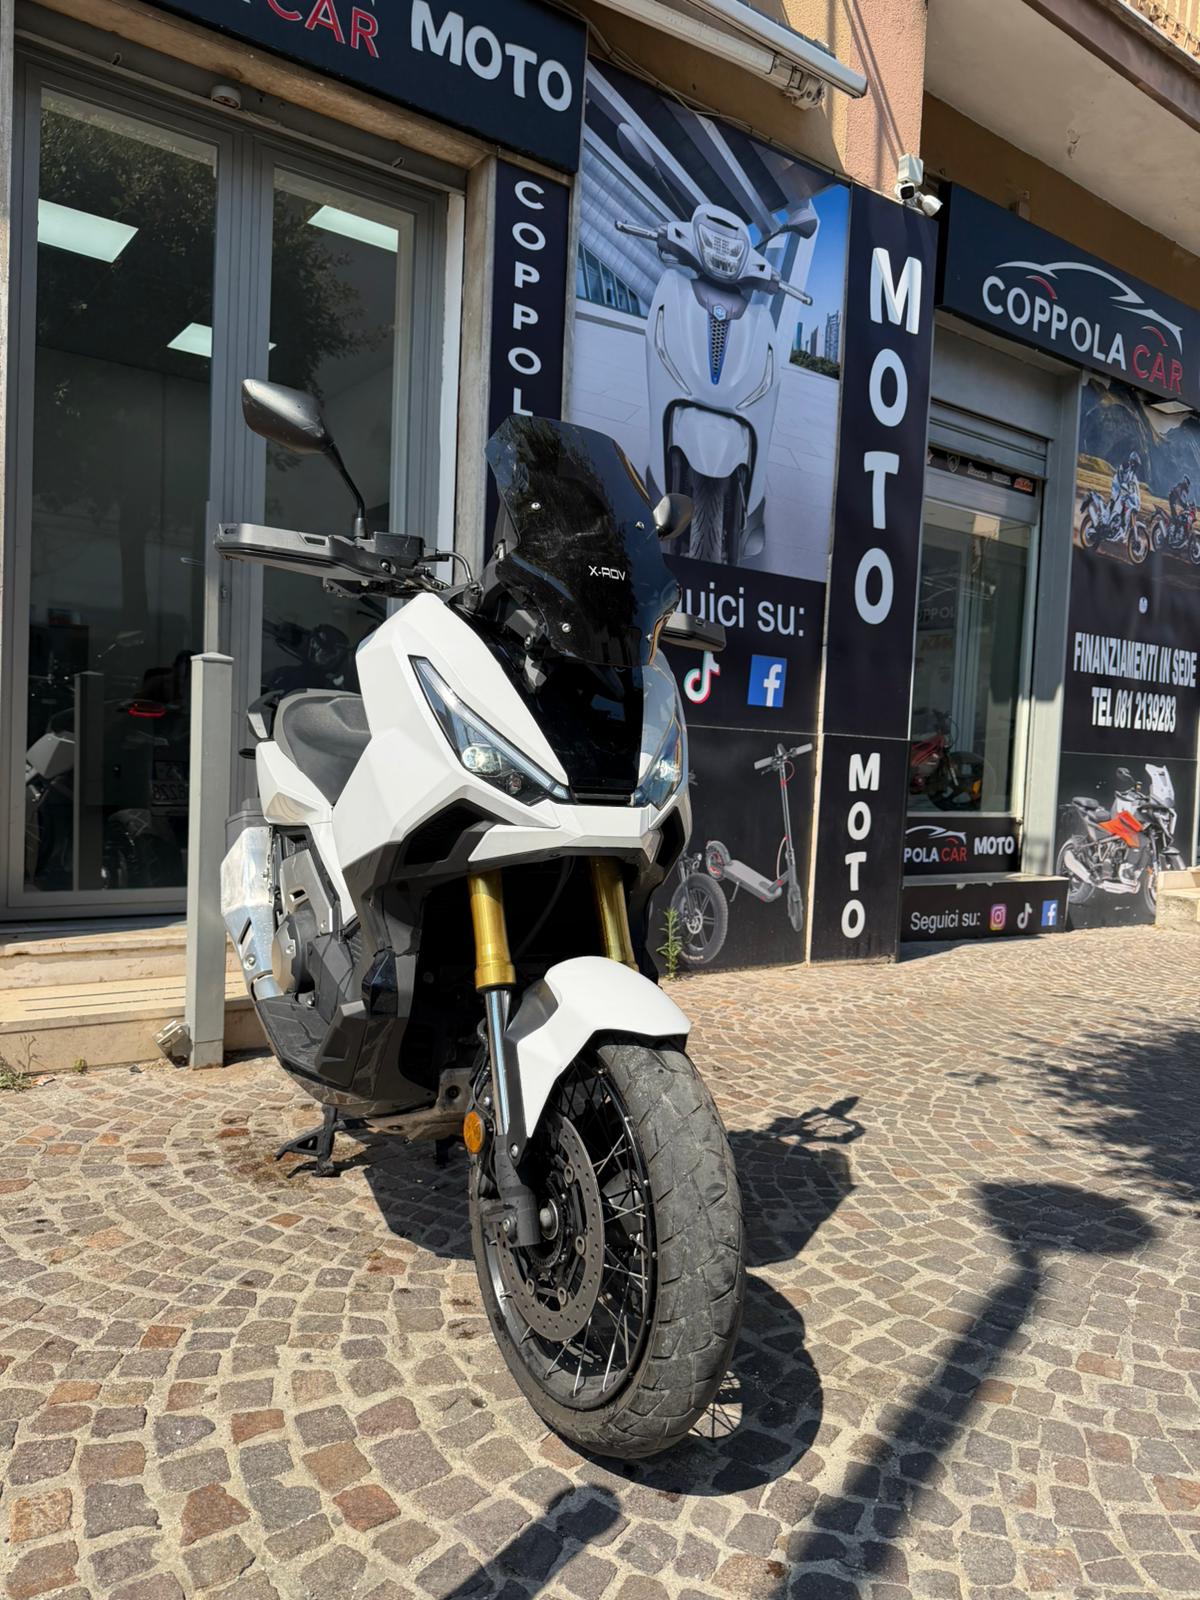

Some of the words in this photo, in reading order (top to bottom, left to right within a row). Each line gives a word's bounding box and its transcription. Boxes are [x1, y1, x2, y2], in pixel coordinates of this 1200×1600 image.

[411, 0, 573, 112] MOTO
[982, 275, 1127, 371] COPPOLA
[1131, 344, 1184, 395] CAR
[854, 247, 922, 625] MOTO
[676, 582, 744, 628] uici
[757, 600, 805, 637] su:
[1073, 631, 1159, 682] FINANZIAMENTI
[1159, 646, 1172, 684] IN
[1172, 648, 1197, 688] SEDE
[1092, 686, 1112, 727] TEL
[1114, 689, 1134, 729] 081
[1134, 691, 1177, 733] 2139283
[841, 752, 881, 939] MOTO
[941, 847, 967, 862] CAR
[973, 836, 1015, 856] MOTO
[910, 909, 958, 934] Seguici
[961, 912, 981, 927] su:
